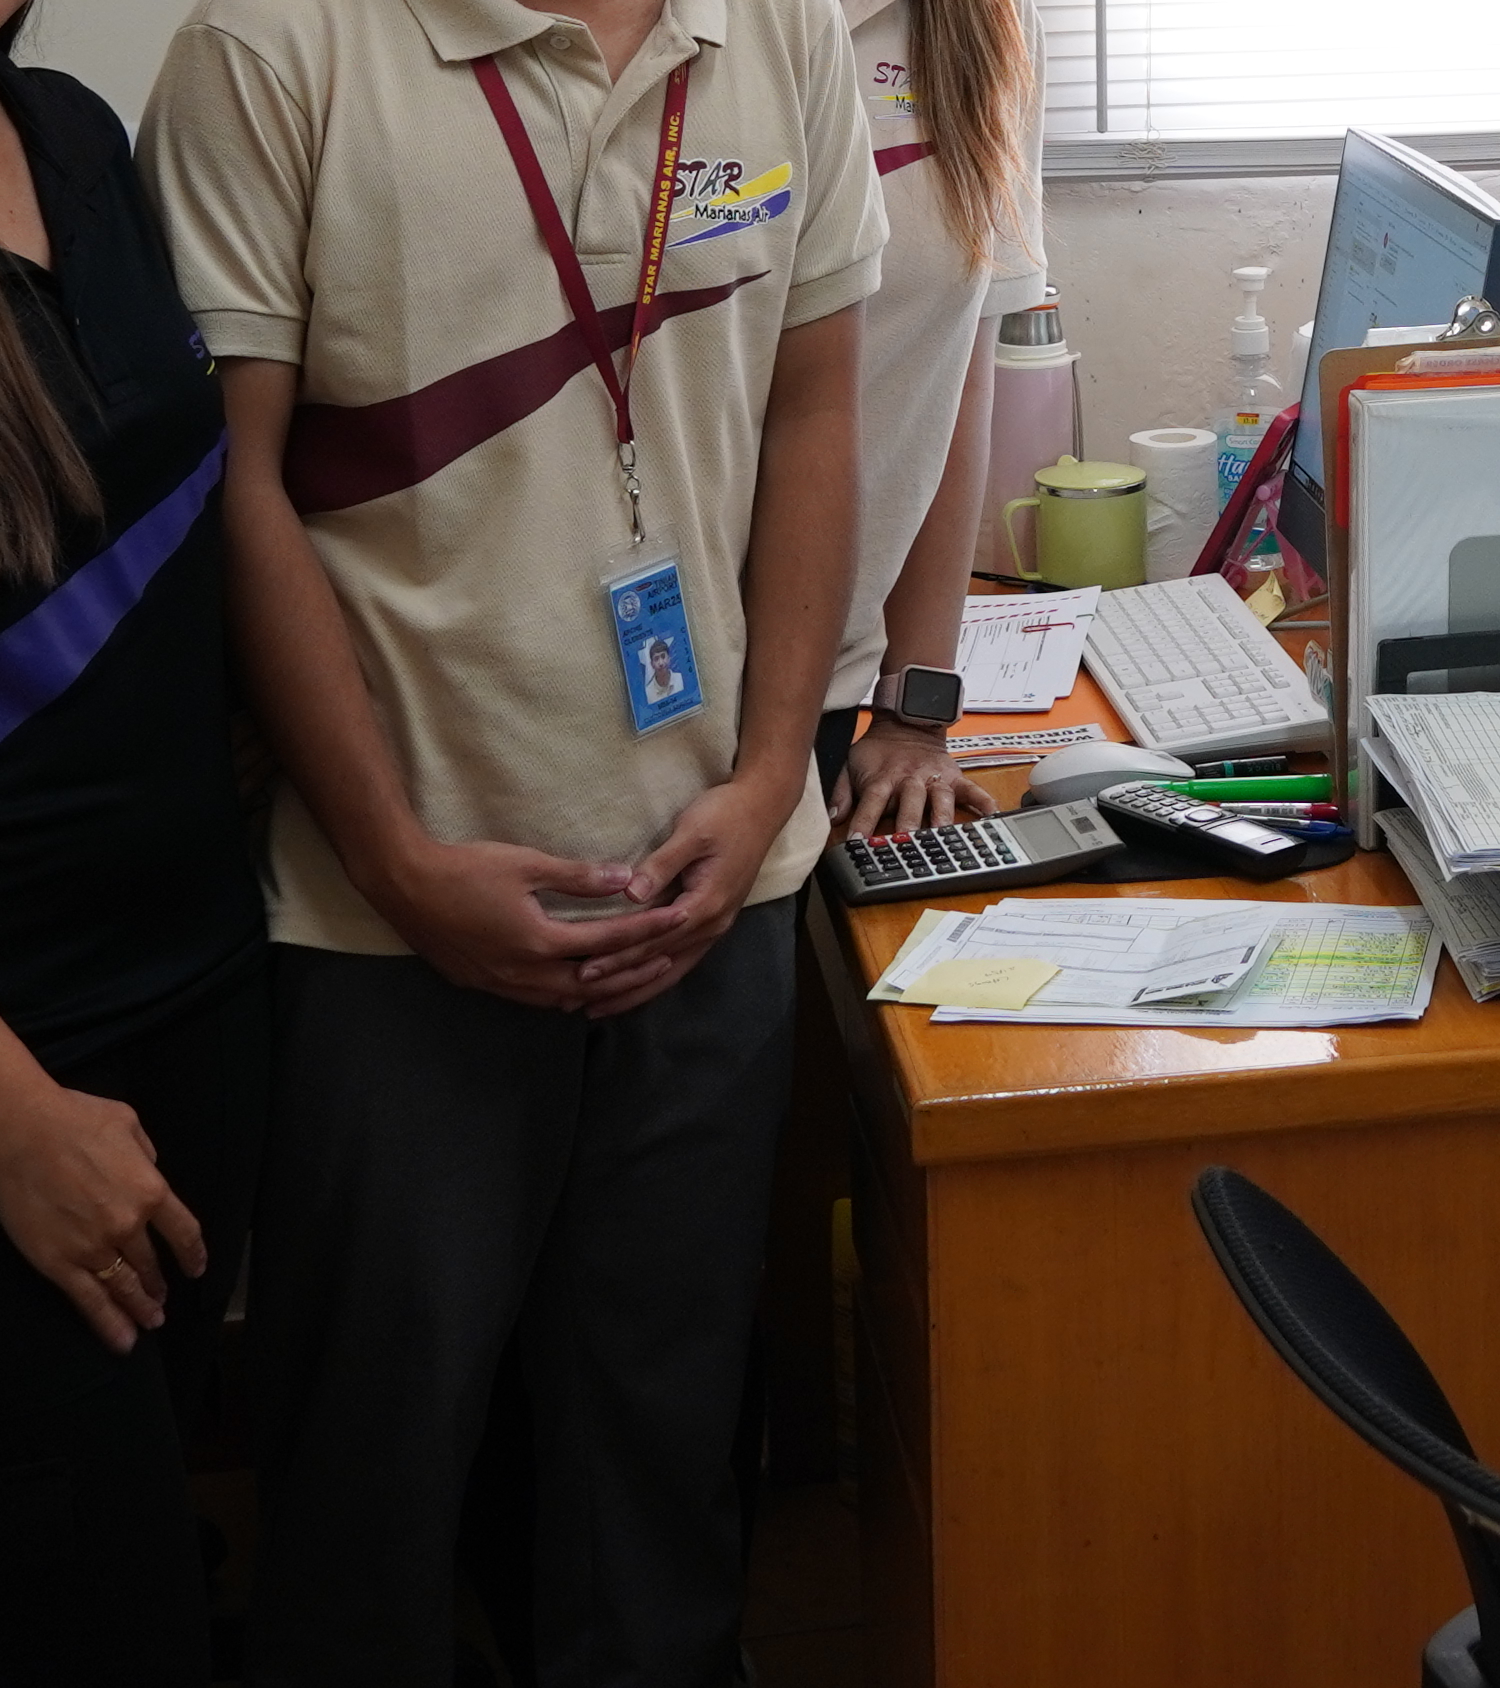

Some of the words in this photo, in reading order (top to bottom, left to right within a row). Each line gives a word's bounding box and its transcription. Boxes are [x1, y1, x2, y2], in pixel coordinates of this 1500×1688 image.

[668, 111, 680, 142] INC.
[663, 146, 678, 178] AIR,
[673, 160, 743, 198] STAR
[650, 179, 671, 261] MARIANAS
[694, 203, 751, 222] Marianas
[754, 207, 769, 224] Air
[642, 265, 657, 305] STAR
